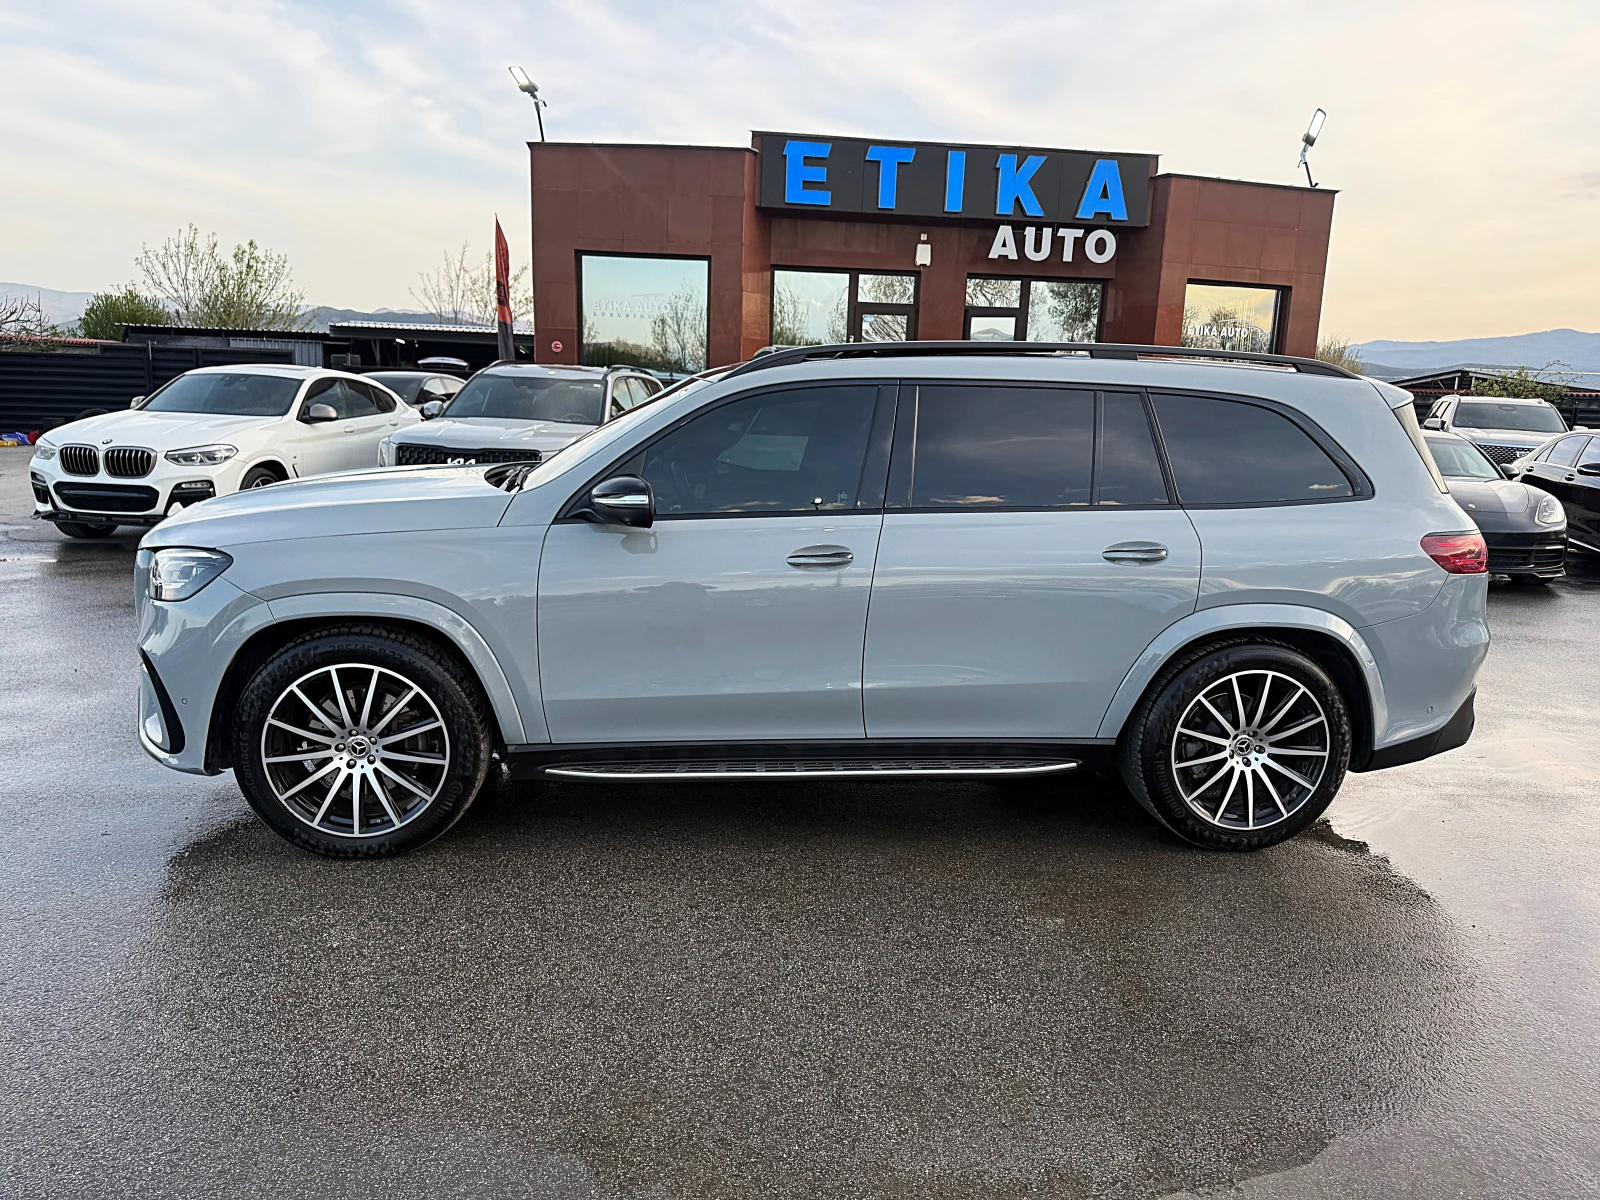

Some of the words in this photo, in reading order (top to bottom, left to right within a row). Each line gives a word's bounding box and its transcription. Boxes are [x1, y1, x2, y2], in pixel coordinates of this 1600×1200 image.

[783, 140, 1128, 221] ETIKA
[988, 225, 1117, 264] AUTO
[593, 300, 631, 312] ETIKA
[636, 302, 671, 313] AUTO
[1187, 325, 1217, 336] ETIKA
[1220, 327, 1249, 338] AUTO
[329, 643, 375, 656] 285/45
[238, 731, 249, 741] 6
[1155, 759, 1186, 819] Continental
